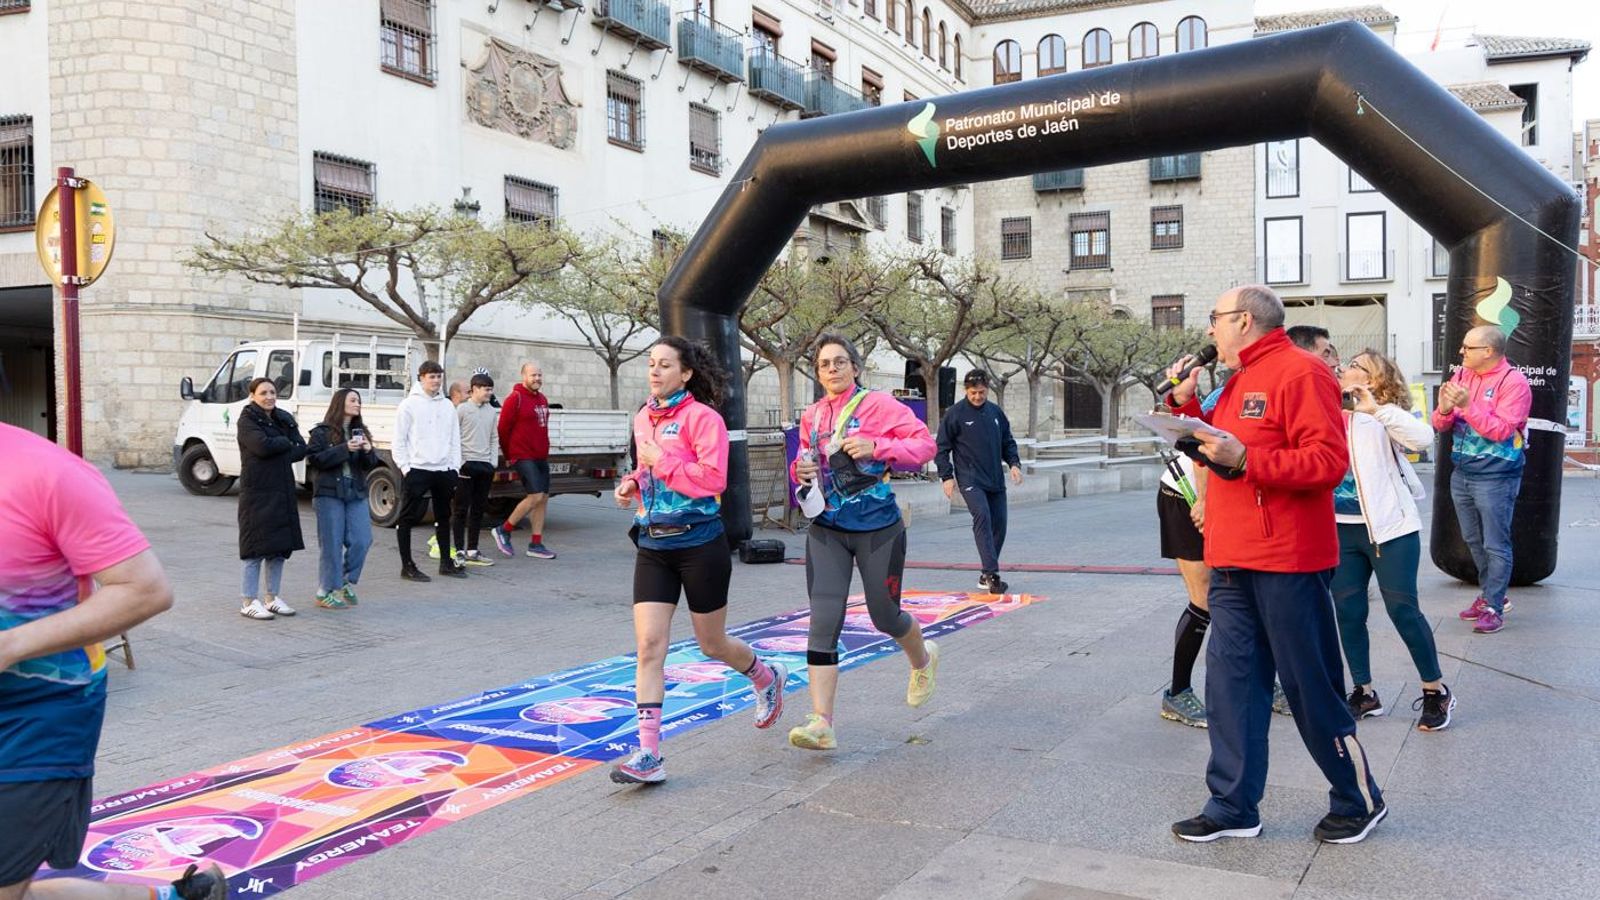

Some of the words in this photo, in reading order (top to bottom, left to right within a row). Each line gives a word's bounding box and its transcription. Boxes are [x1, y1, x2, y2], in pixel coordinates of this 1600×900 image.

[945, 110, 1016, 132] Patronato
[1020, 94, 1096, 116] Municipal
[1100, 90, 1121, 107] de
[946, 129, 1014, 151] Deportes
[1017, 124, 1037, 139] de
[1040, 116, 1080, 135] Jaén
[1528, 377, 1545, 387] aén
[1546, 366, 1557, 376] de
[91, 778, 200, 813] TEAMERG
[480, 760, 577, 800] TEAMERGY
[295, 820, 422, 872] TEAMERGY
